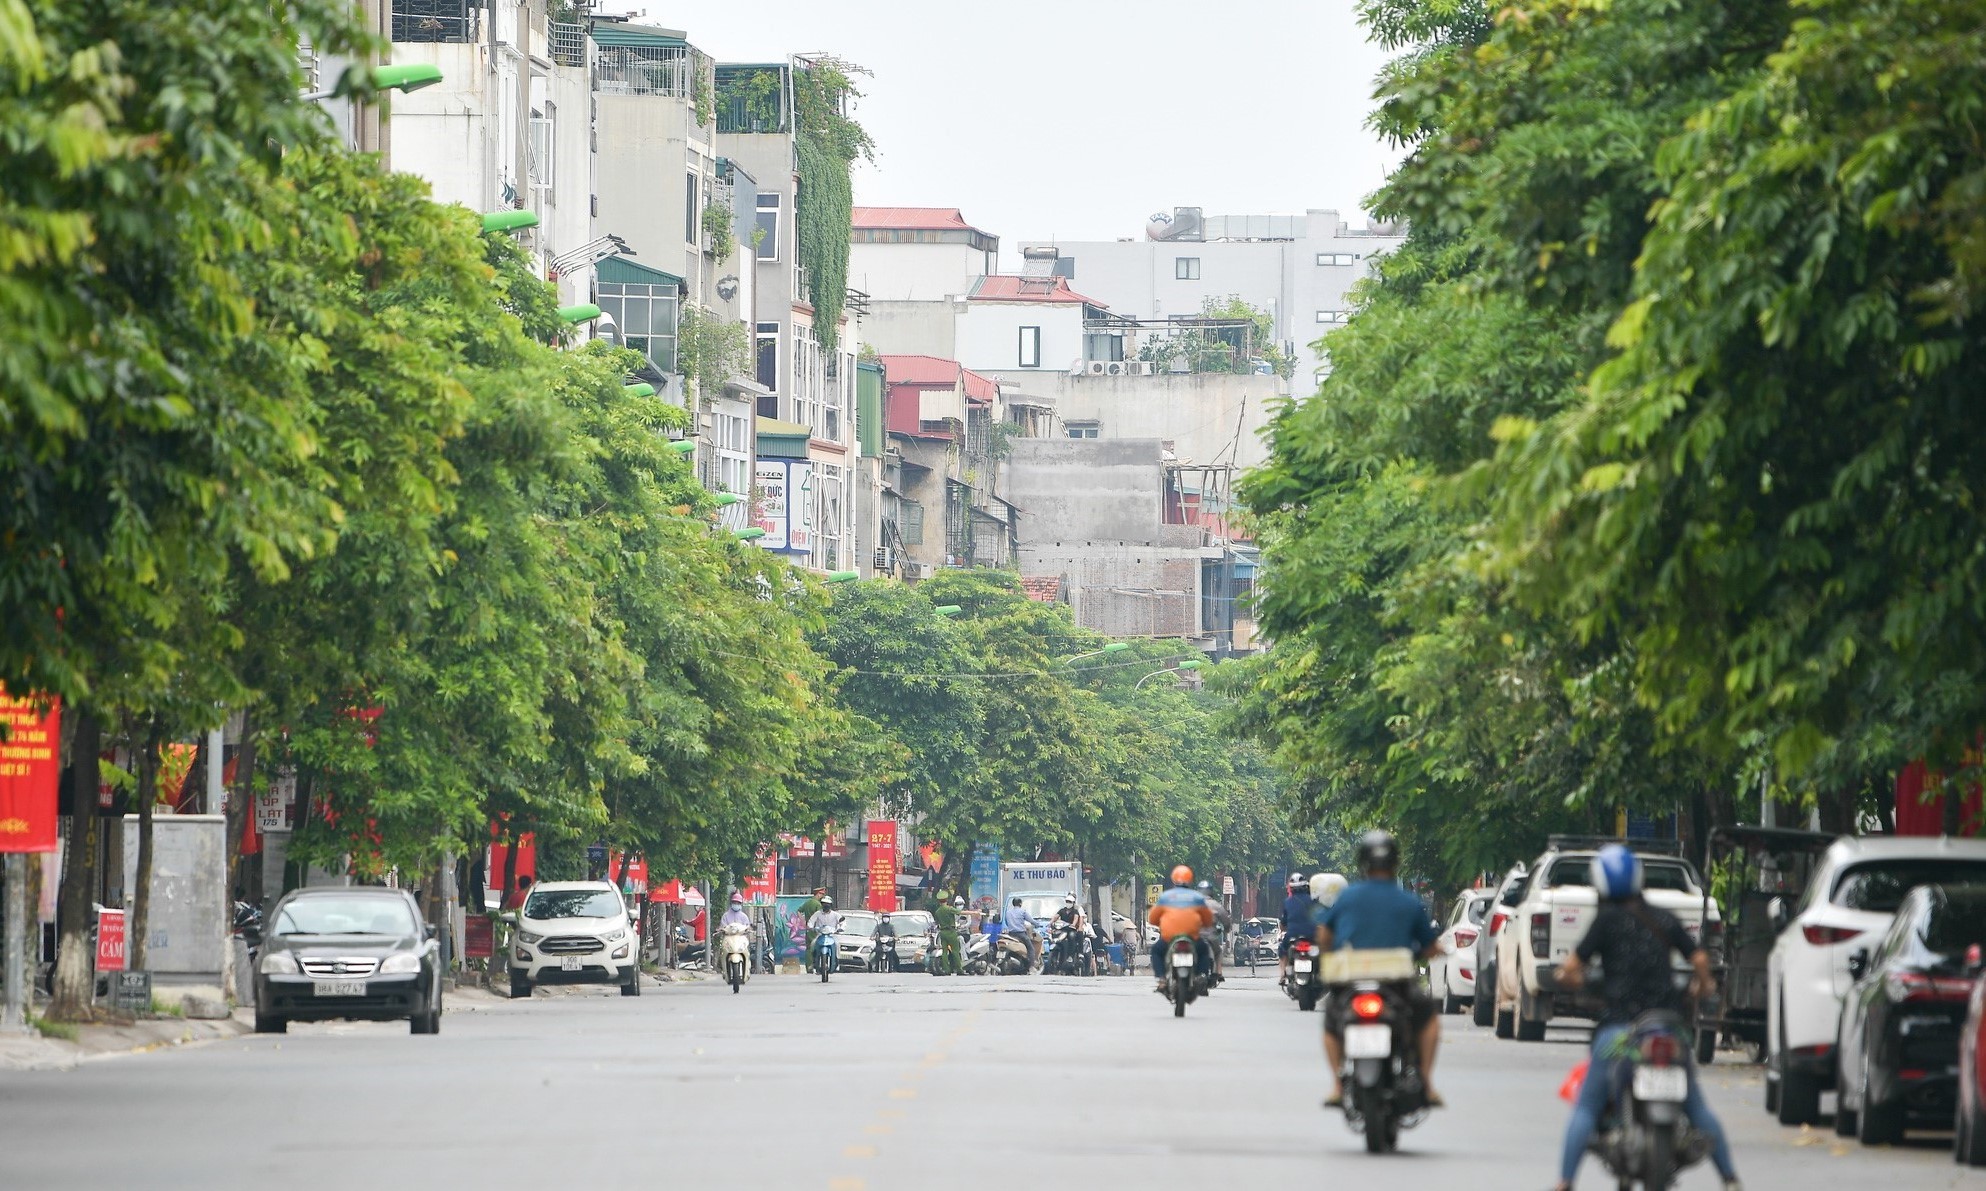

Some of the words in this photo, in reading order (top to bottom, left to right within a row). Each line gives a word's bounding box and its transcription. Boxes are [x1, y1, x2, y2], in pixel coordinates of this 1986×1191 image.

[871, 833, 892, 843] 27-7
[1013, 870, 1025, 880] XE
[1027, 869, 1046, 880] THƯ
[100, 935, 123, 958] CẤM
